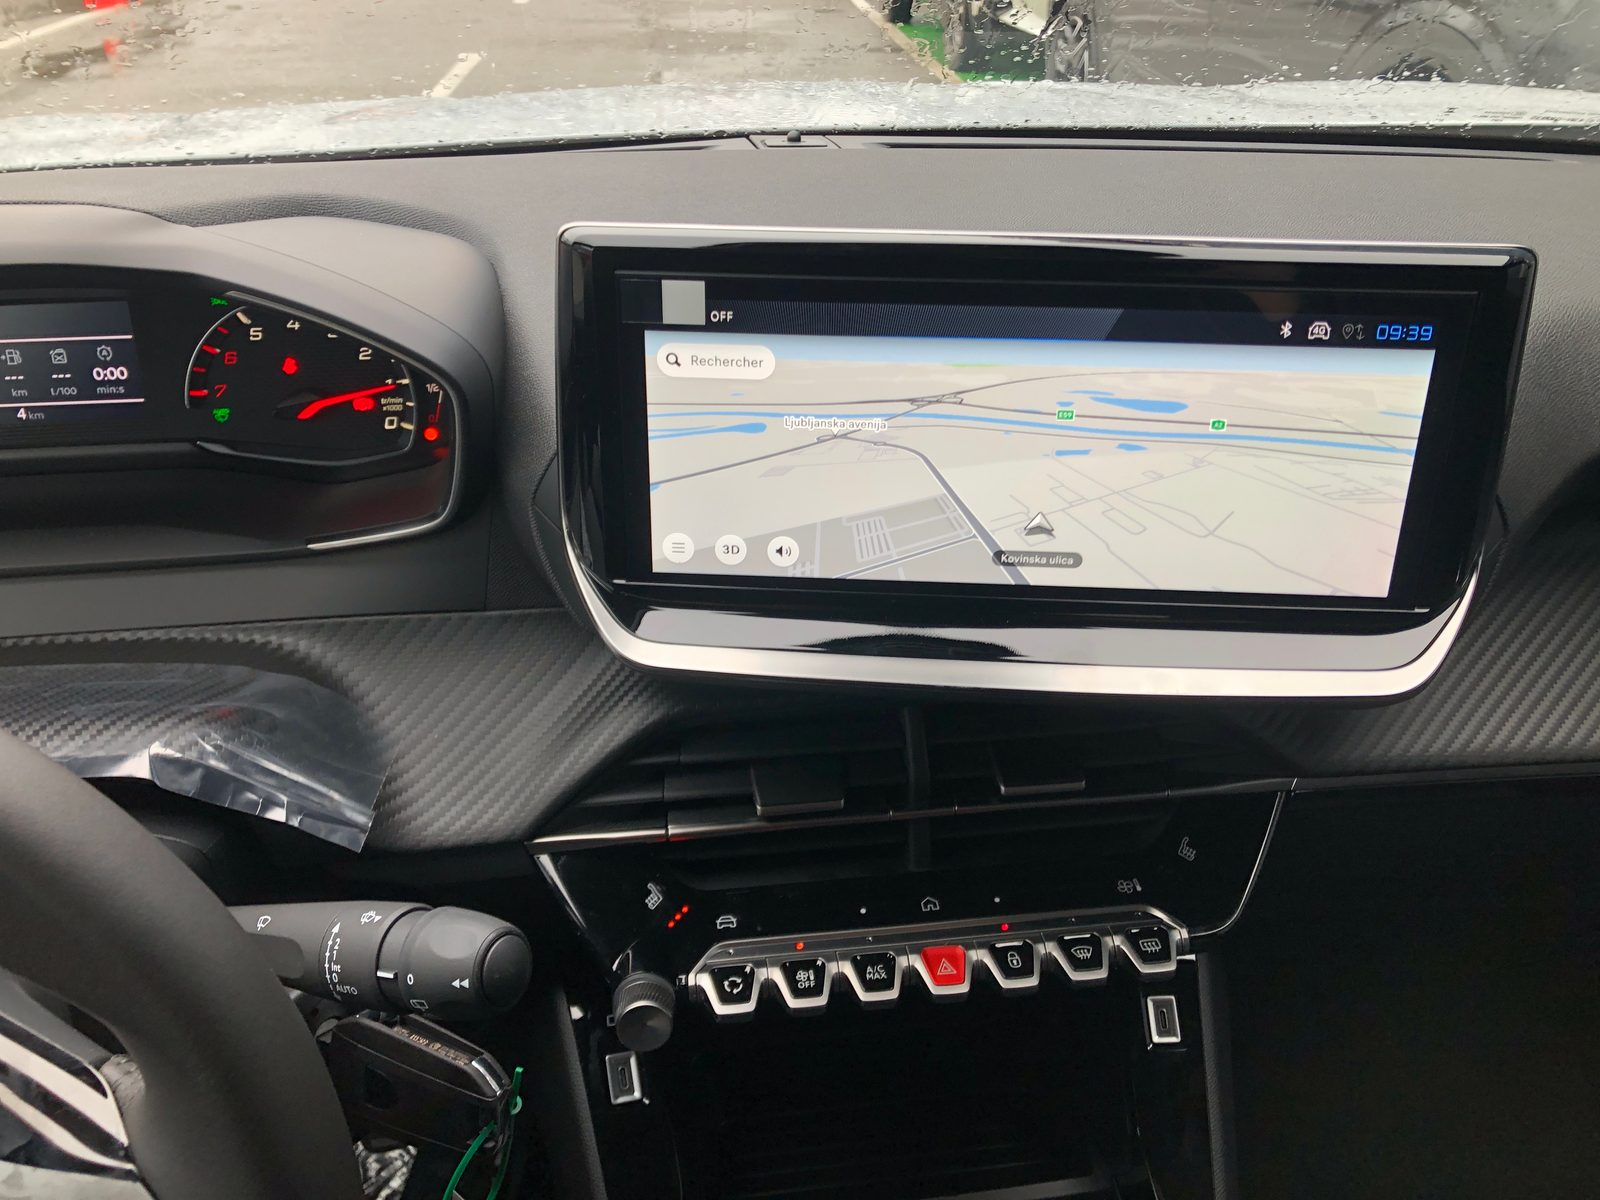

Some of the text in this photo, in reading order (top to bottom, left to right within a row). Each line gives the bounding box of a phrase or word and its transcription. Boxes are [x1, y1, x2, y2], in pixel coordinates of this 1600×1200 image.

[710, 310, 733, 322] OFF
[286, 320, 300, 330] 4
[249, 327, 263, 341] 5
[1376, 323, 1433, 341] 09:39
[224, 351, 238, 365] 6
[358, 347, 372, 360] 2
[690, 354, 764, 368] Rechercher
[92, 366, 128, 381] 0:00
[11, 388, 28, 397] km
[96, 385, 126, 394] min:s
[213, 383, 228, 398] 7
[16, 407, 45, 421] 4 km
[384, 416, 397, 430] 0
[784, 417, 887, 432] Ljubljanska avenija
[722, 544, 740, 555] 3D
[1000, 553, 1074, 565] Kovinska ulica
[333, 938, 341, 950] 2
[333, 950, 337, 961] 1
[331, 962, 341, 972] Int
[866, 964, 885, 973] A/C
[332, 973, 339, 983] 0
[406, 973, 414, 985] 0
[866, 972, 887, 981] MAX
[336, 984, 358, 995] AUTO
[797, 980, 816, 989] OFF
